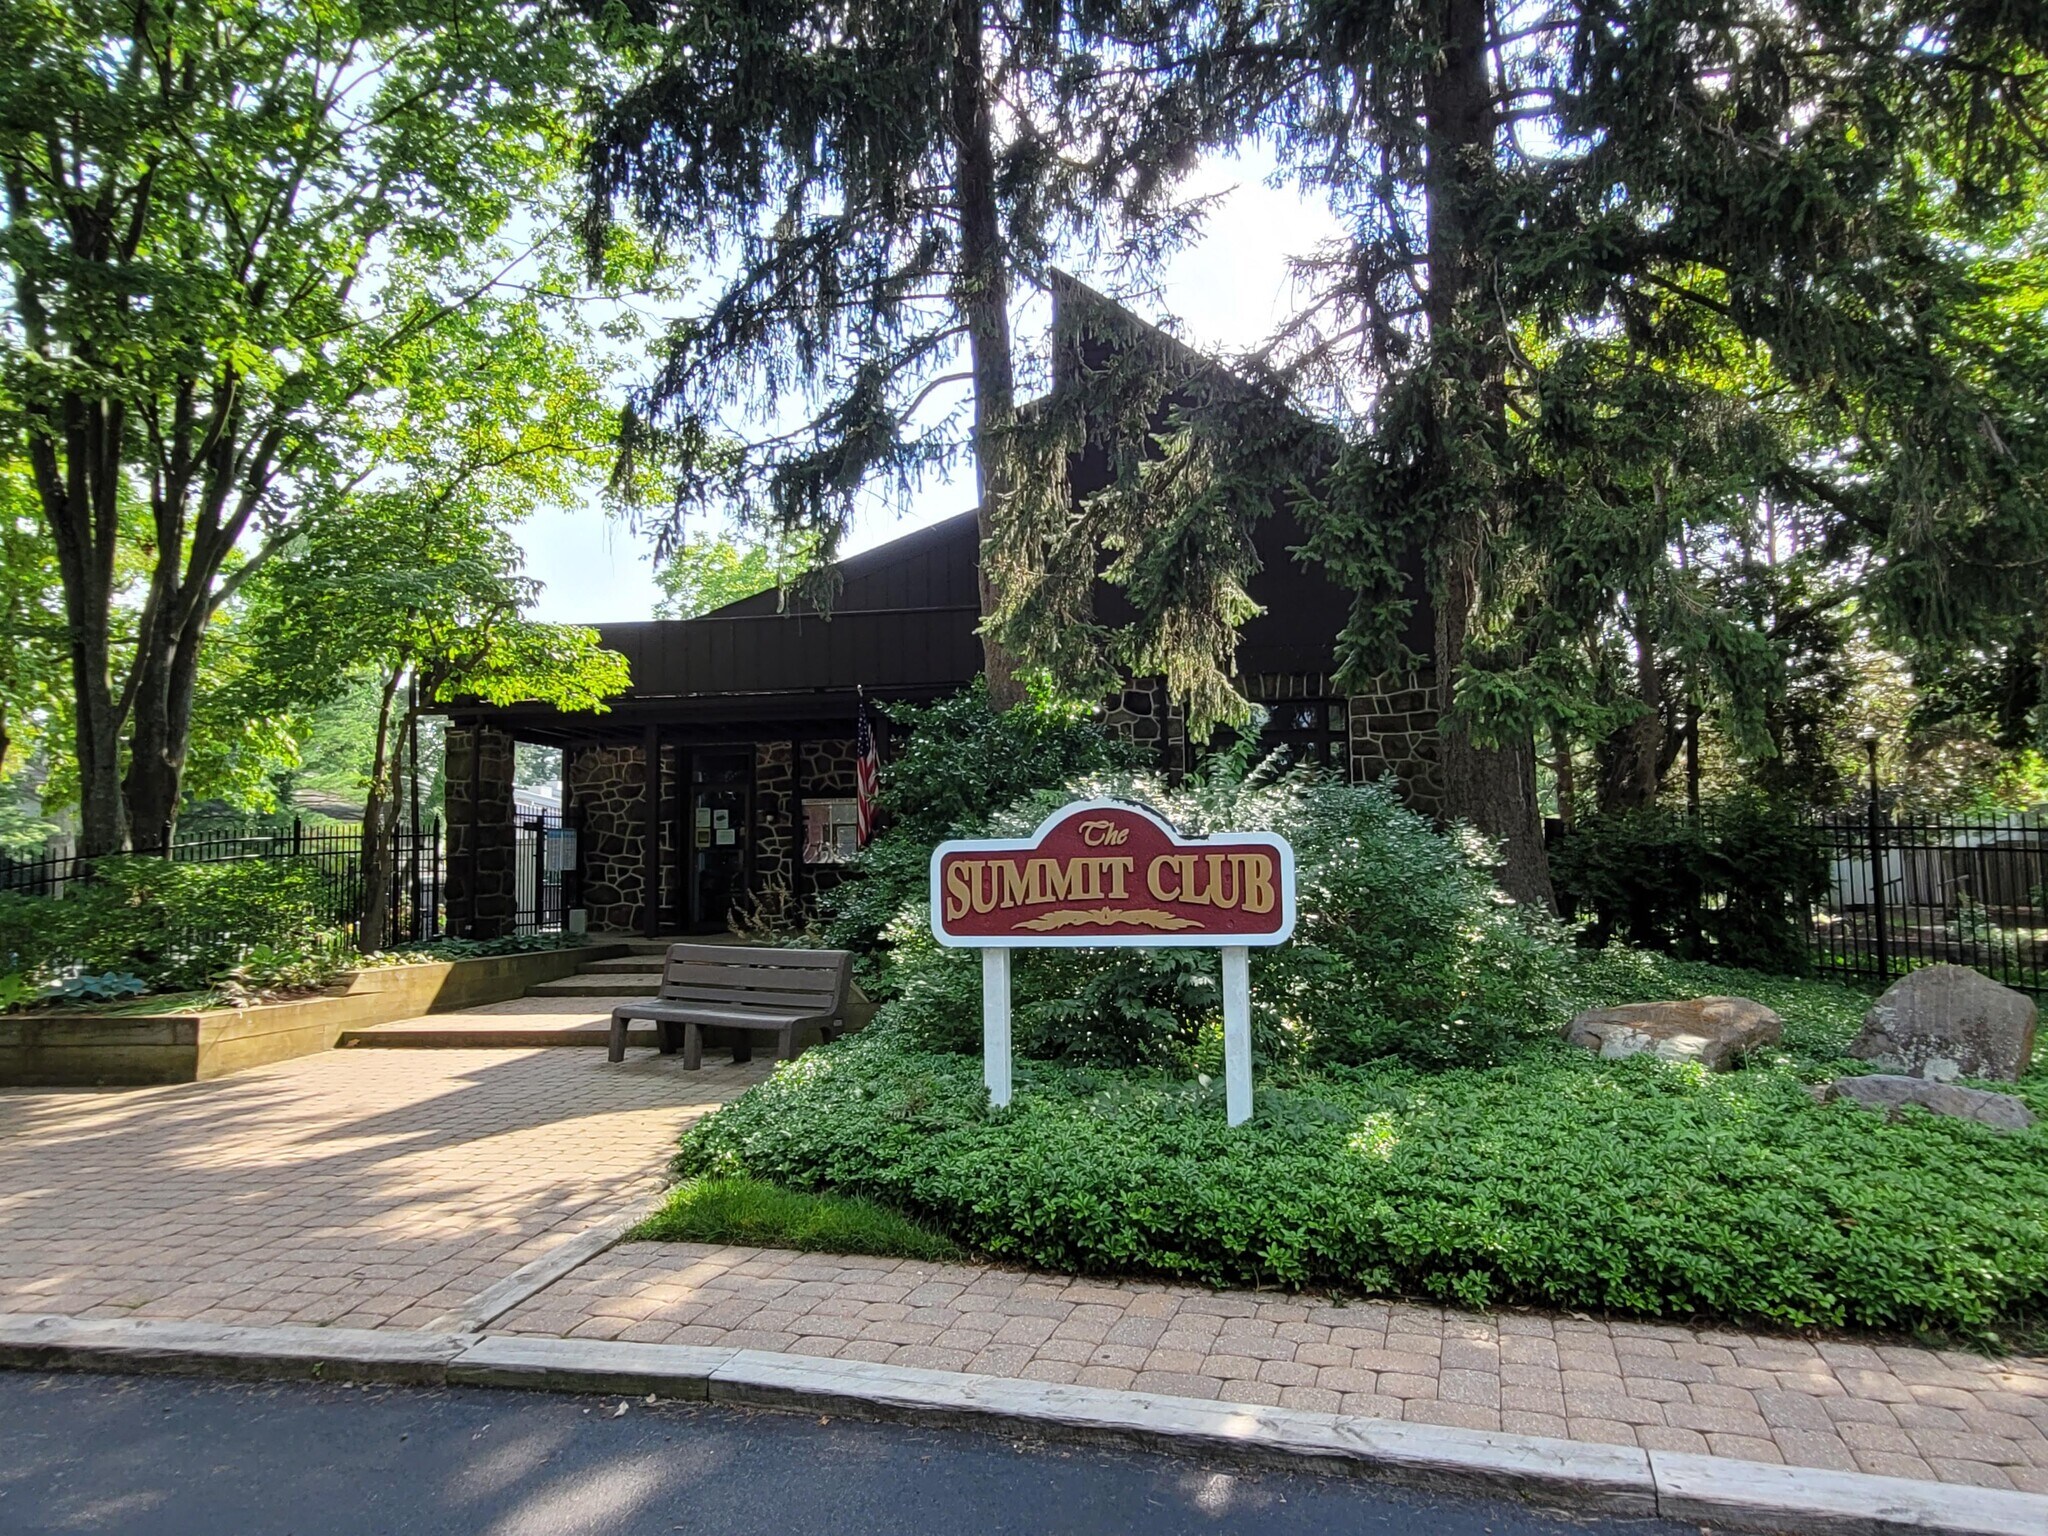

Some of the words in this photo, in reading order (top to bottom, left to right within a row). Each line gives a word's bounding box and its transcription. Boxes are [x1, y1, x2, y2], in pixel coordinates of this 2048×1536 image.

[1078, 820, 1129, 846] The
[946, 857, 1134, 921] SUMMIT
[1147, 854, 1275, 914] CLUB
